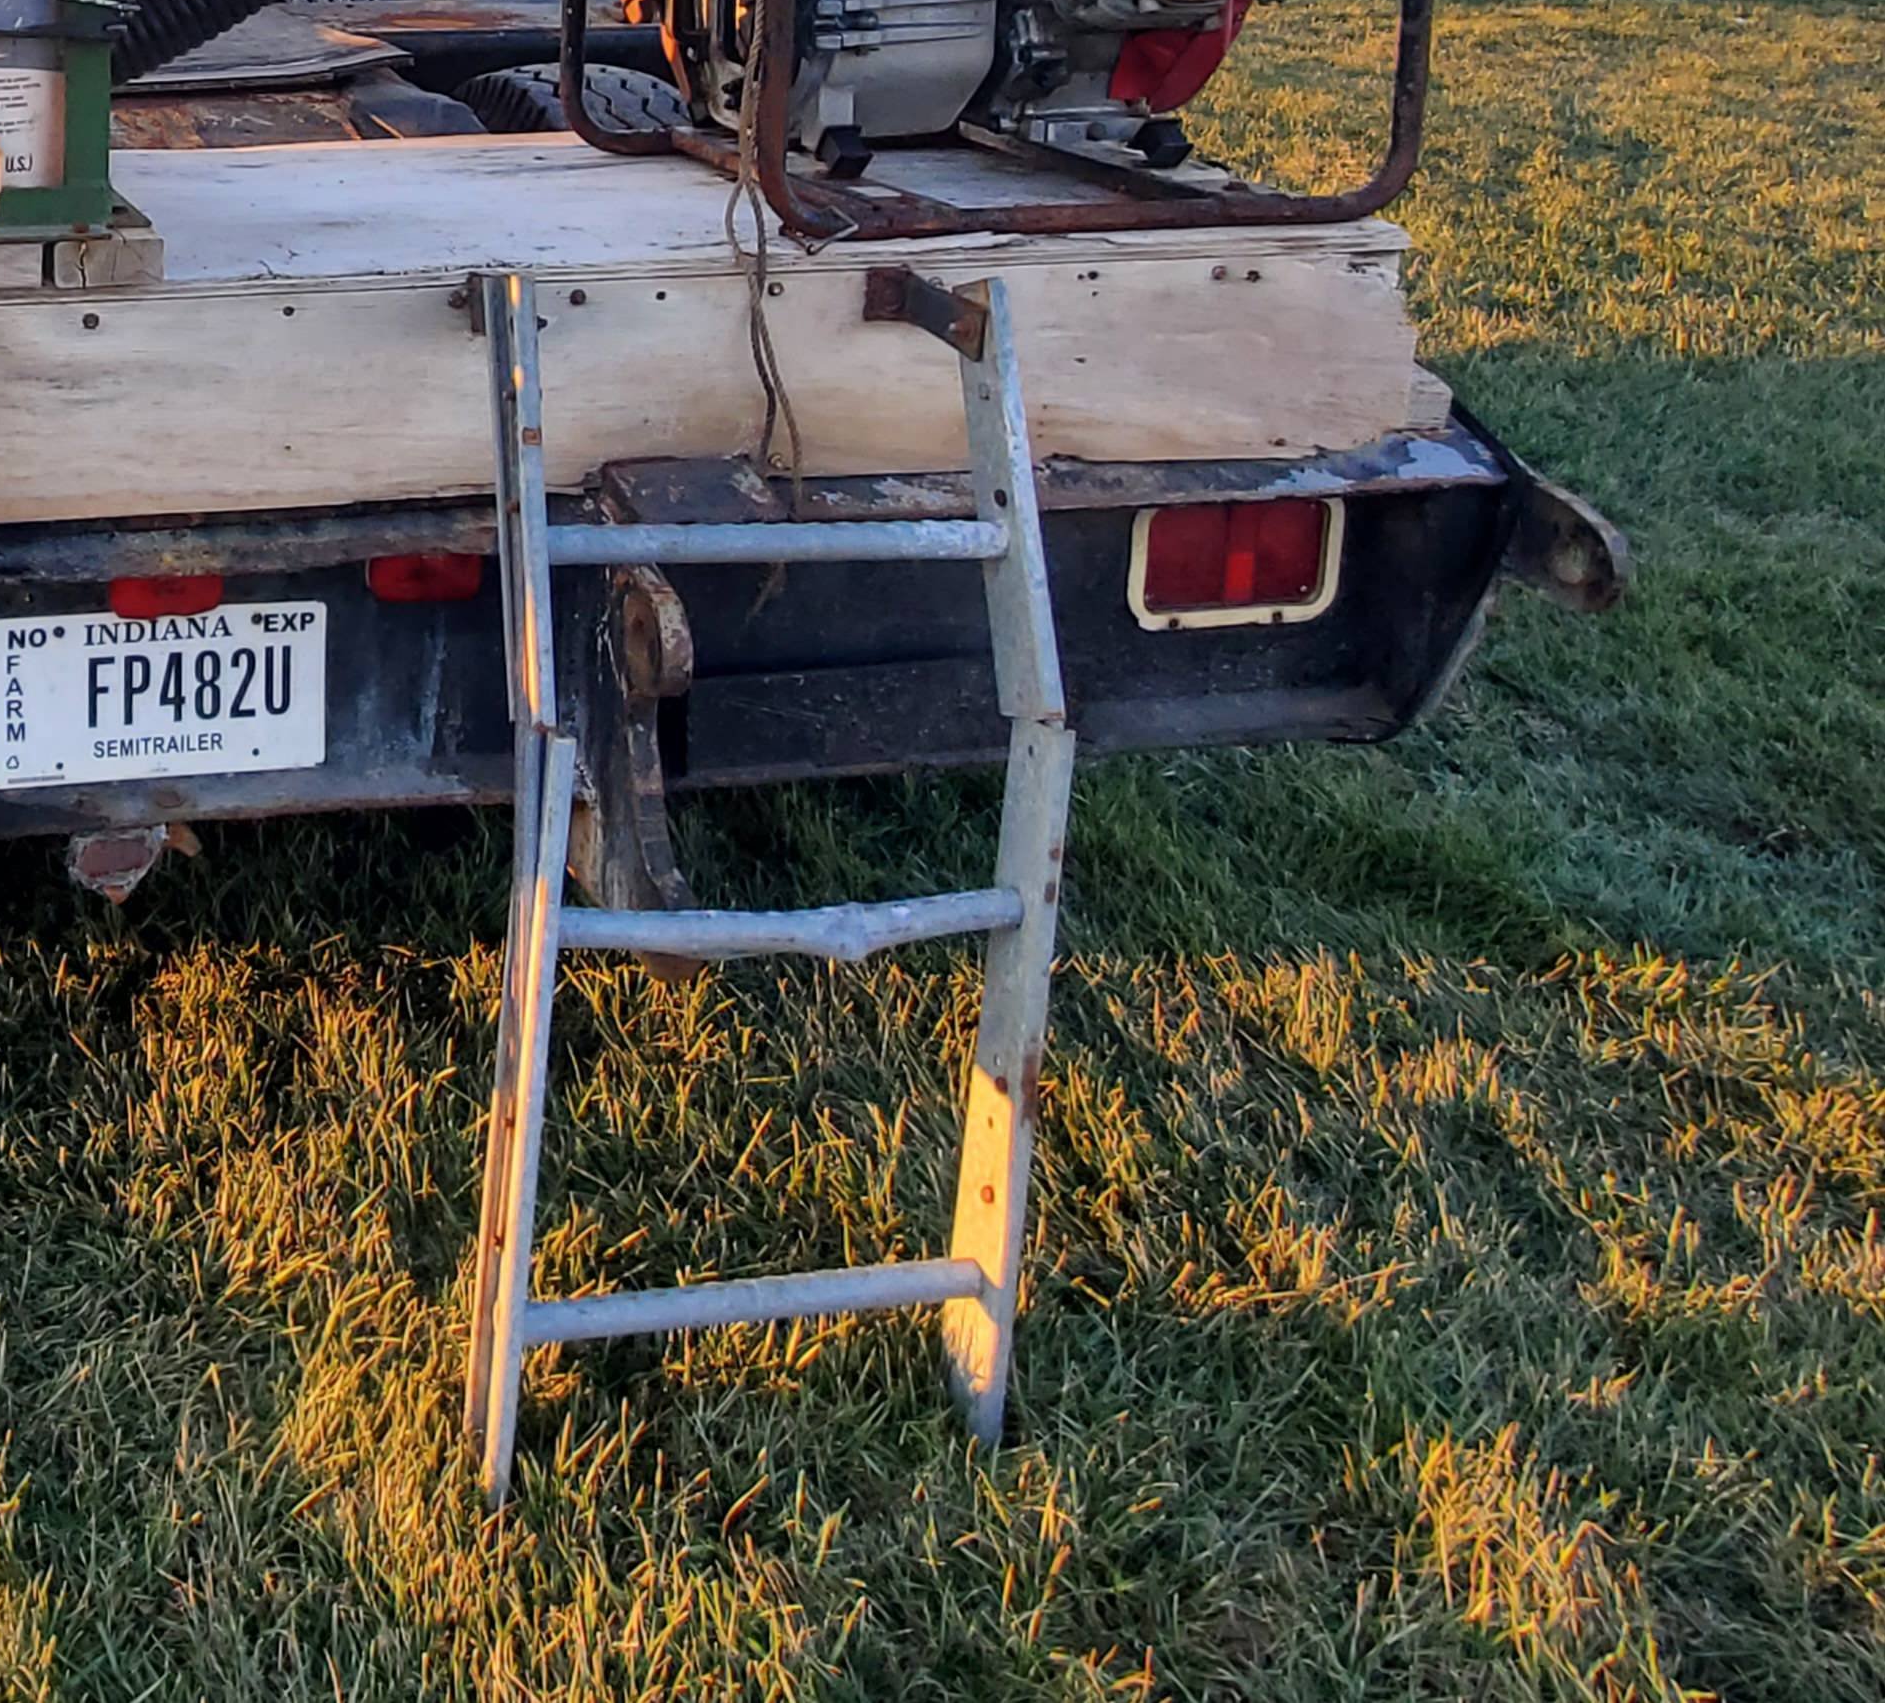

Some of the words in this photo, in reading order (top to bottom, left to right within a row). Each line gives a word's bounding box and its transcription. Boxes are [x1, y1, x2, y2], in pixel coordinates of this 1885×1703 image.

[84, 614, 233, 647] INDIANA
[263, 612, 316, 633] EXP
[8, 628, 47, 650] NO
[6, 655, 27, 743] FARM
[87, 645, 292, 729] FP482U
[93, 733, 223, 759] SEMITRAILER
